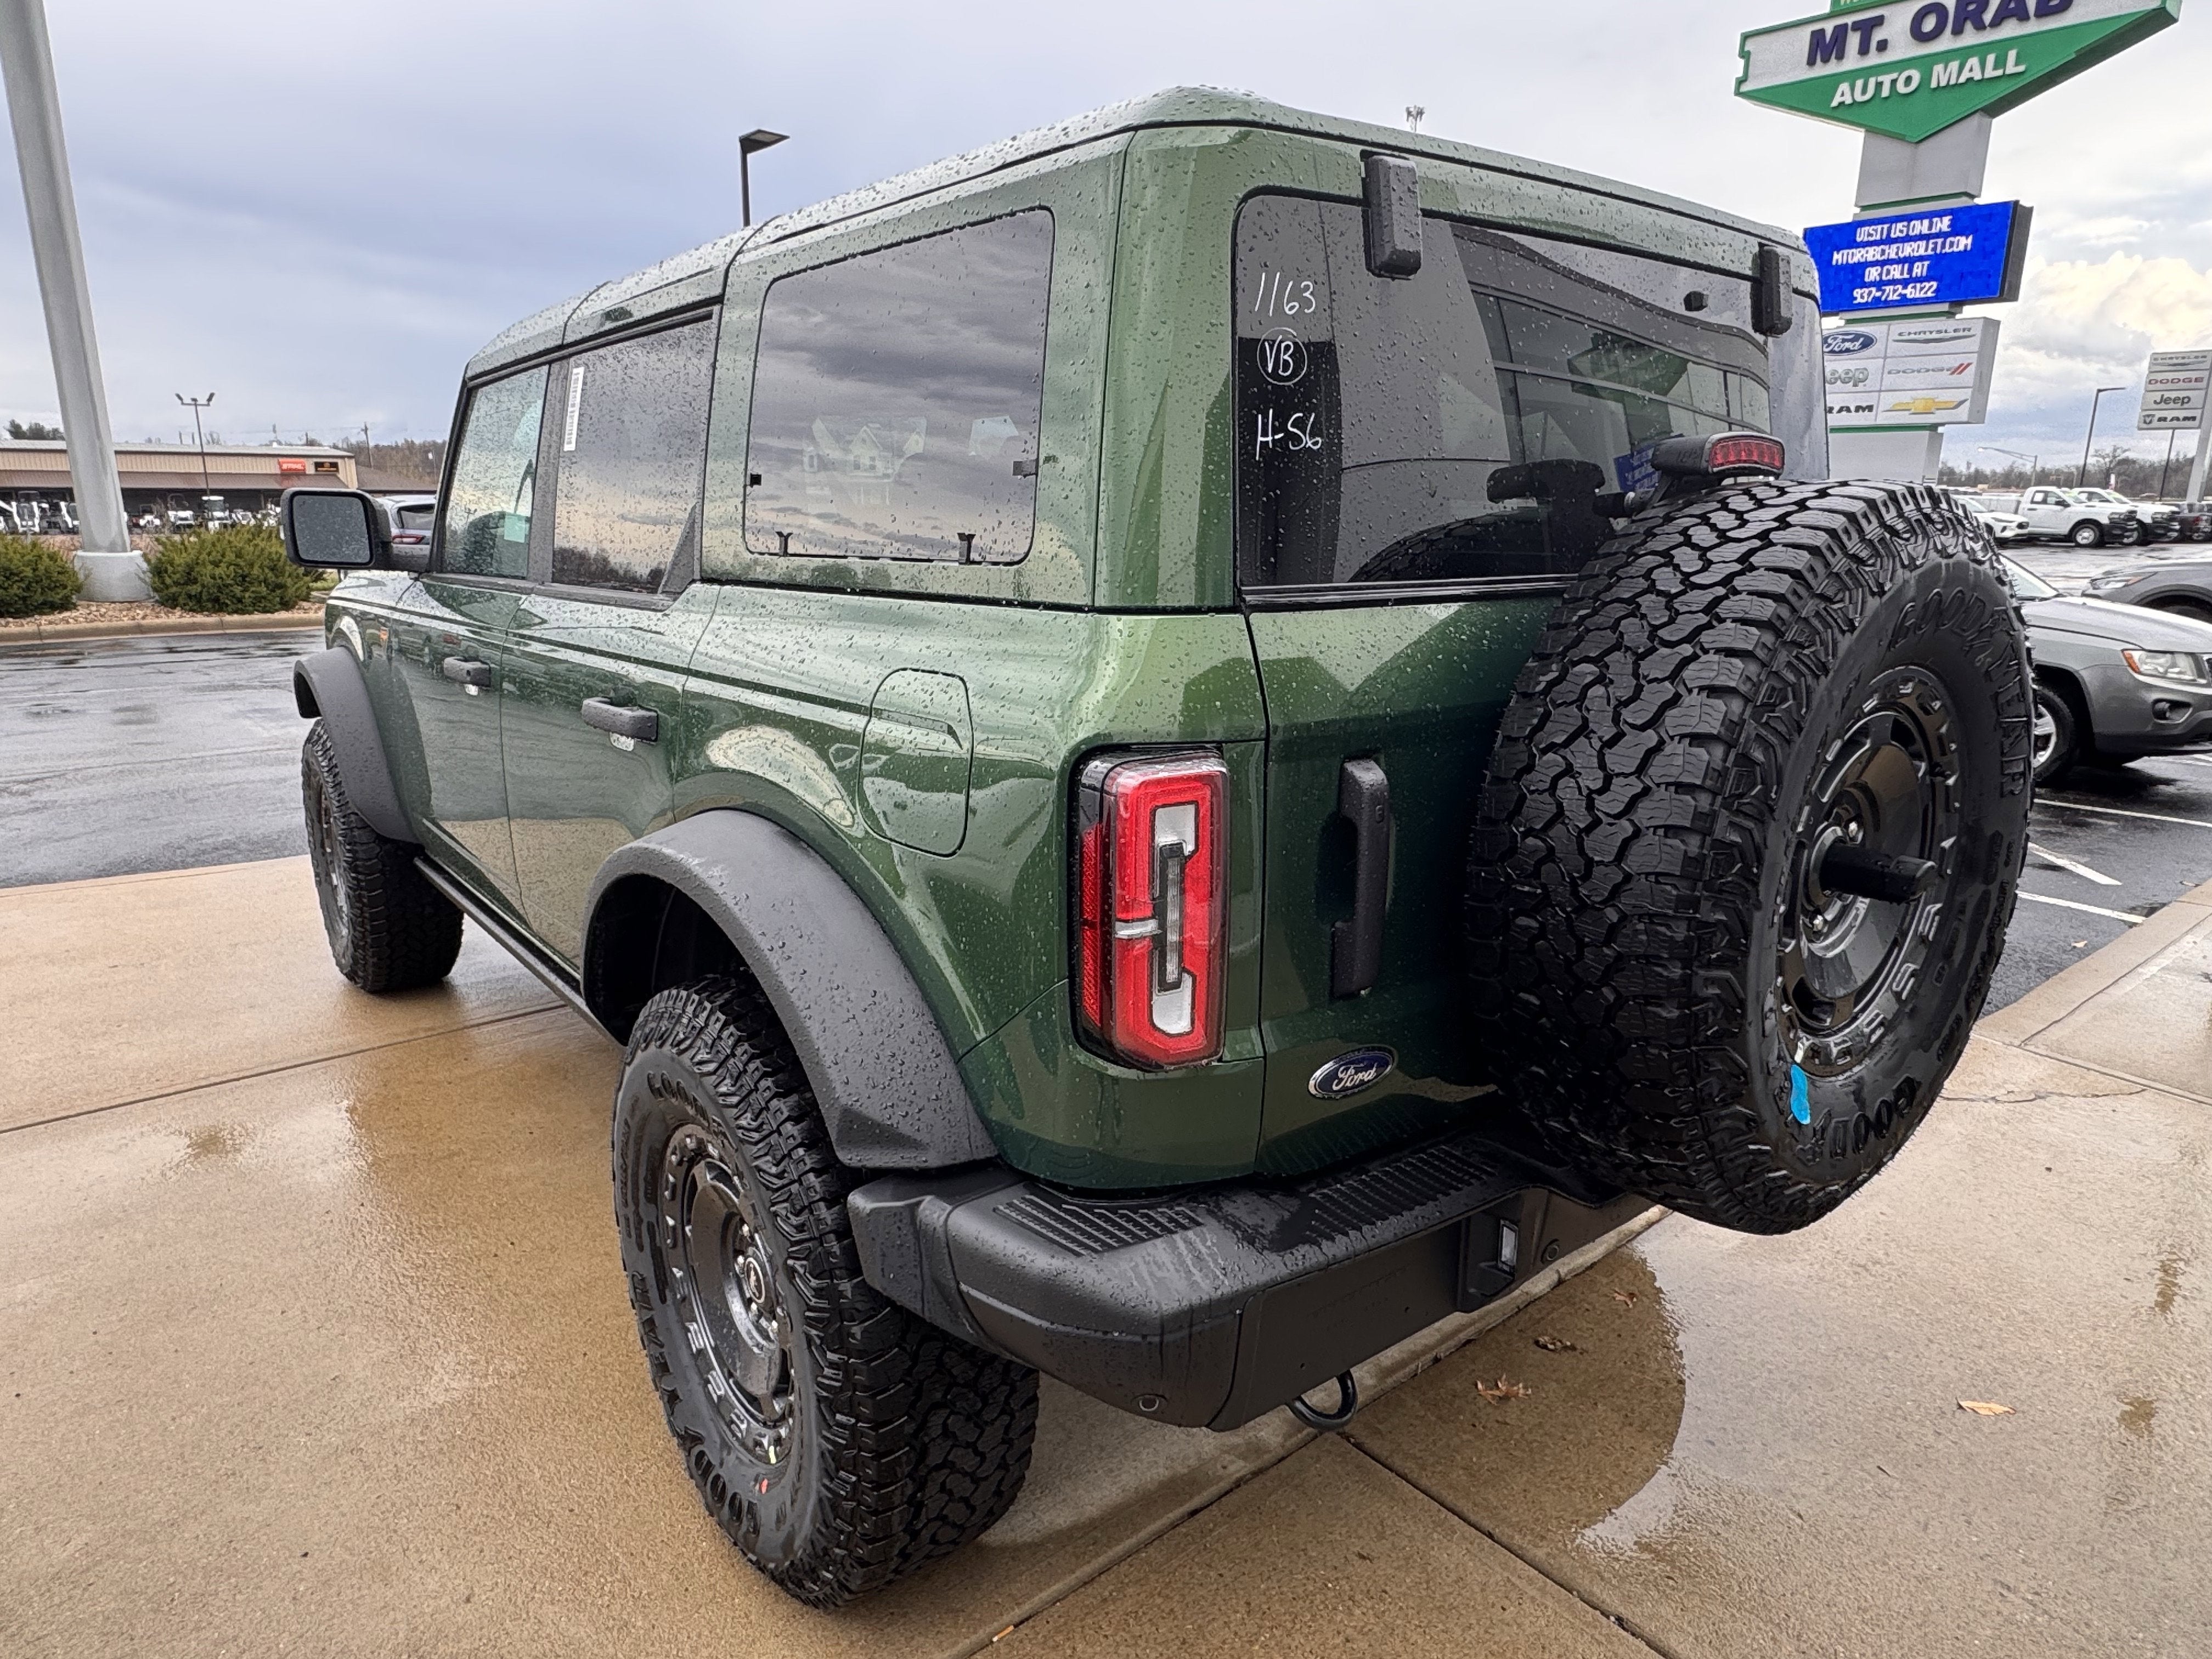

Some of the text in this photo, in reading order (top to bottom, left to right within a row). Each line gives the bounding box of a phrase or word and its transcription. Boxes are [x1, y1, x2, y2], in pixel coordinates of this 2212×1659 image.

[1806, 14, 1888, 66] MT.
[1830, 48, 2027, 108] AUTO MALL
[1890, 222, 1908, 238] US
[1909, 216, 1953, 236] ONLINE
[1832, 234, 1973, 266] MTORABCHEVROLET.COM
[1864, 261, 1931, 282] OR CALL AT
[1254, 272, 1316, 317] 1163
[1853, 281, 1938, 304] 937-712-6122
[1824, 334, 1865, 352] Ford
[1898, 328, 1972, 336] CHRYSLER
[1265, 335, 1294, 376] VB
[1825, 368, 1870, 387] eep
[2148, 377, 2204, 385] DODGE
[2153, 394, 2191, 407] Jeep
